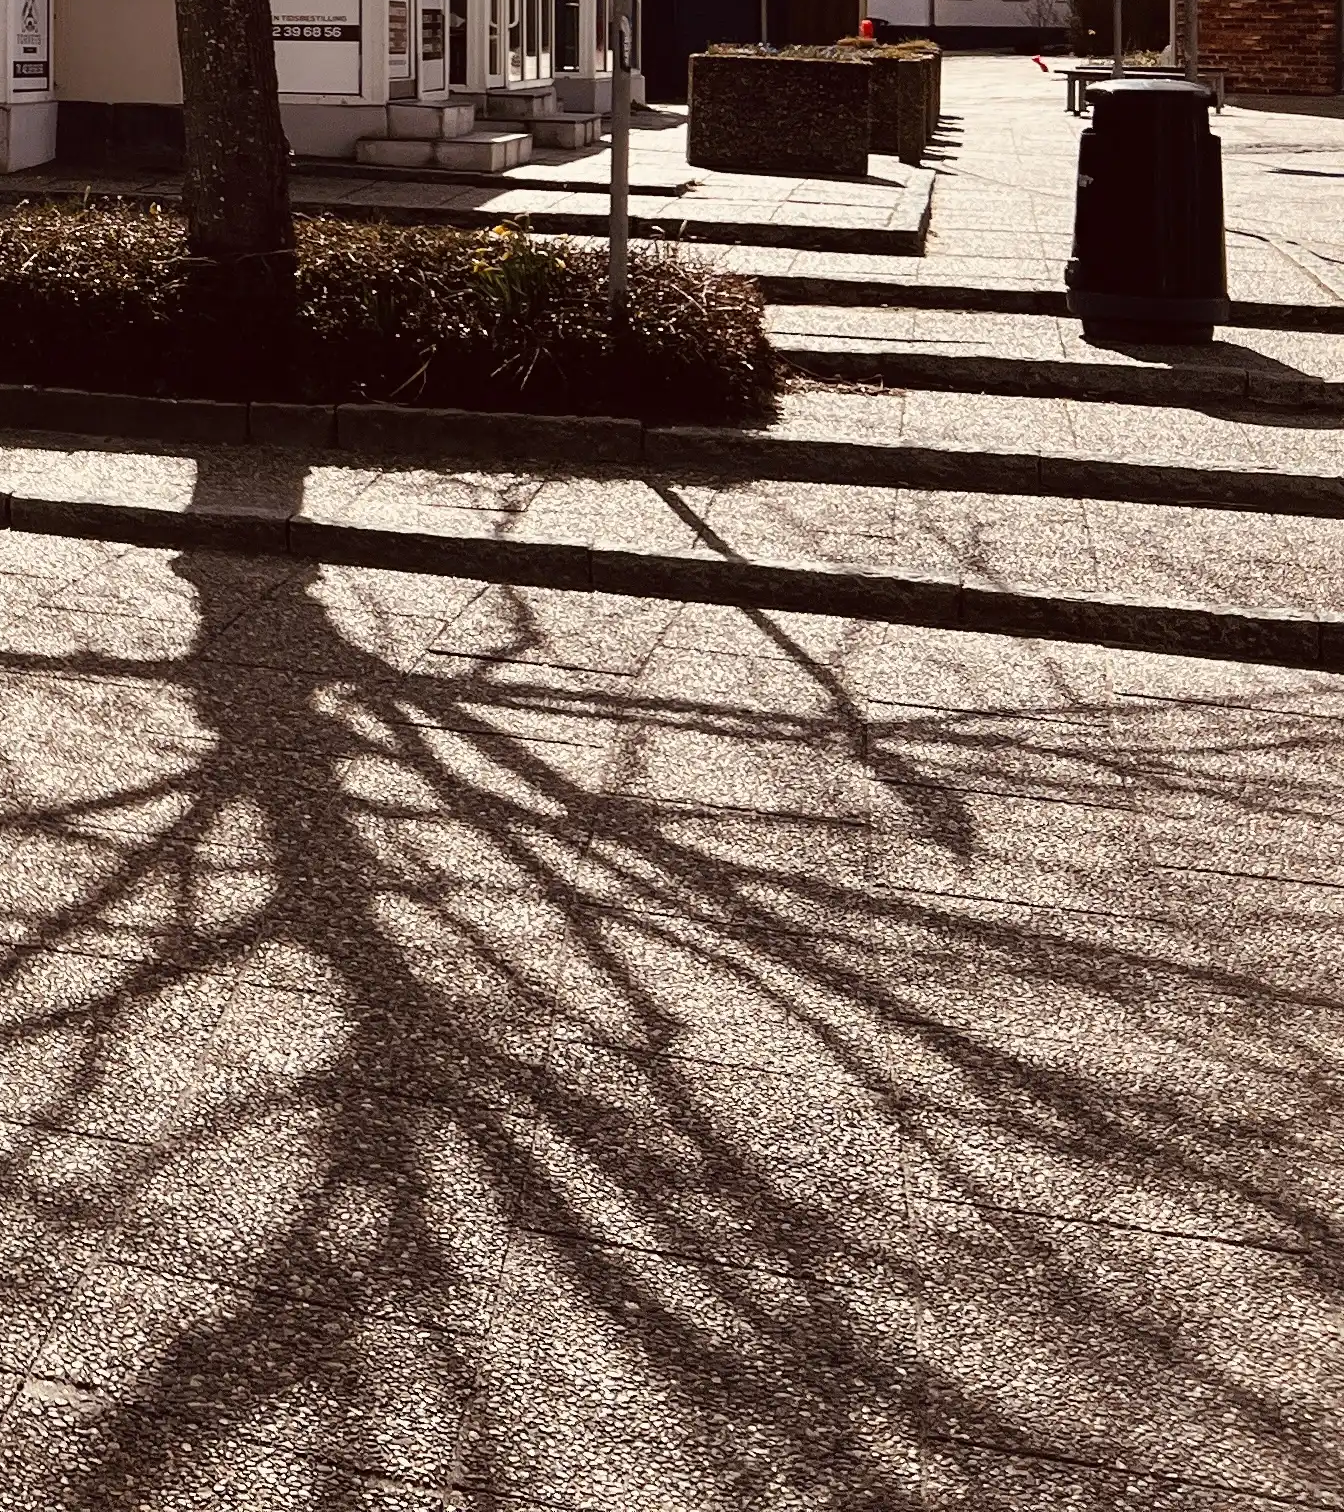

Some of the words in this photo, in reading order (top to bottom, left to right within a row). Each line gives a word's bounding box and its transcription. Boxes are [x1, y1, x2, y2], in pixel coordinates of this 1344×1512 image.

[283, 27, 301, 37] 39
[303, 27, 321, 37] 68
[324, 27, 342, 37] 56
